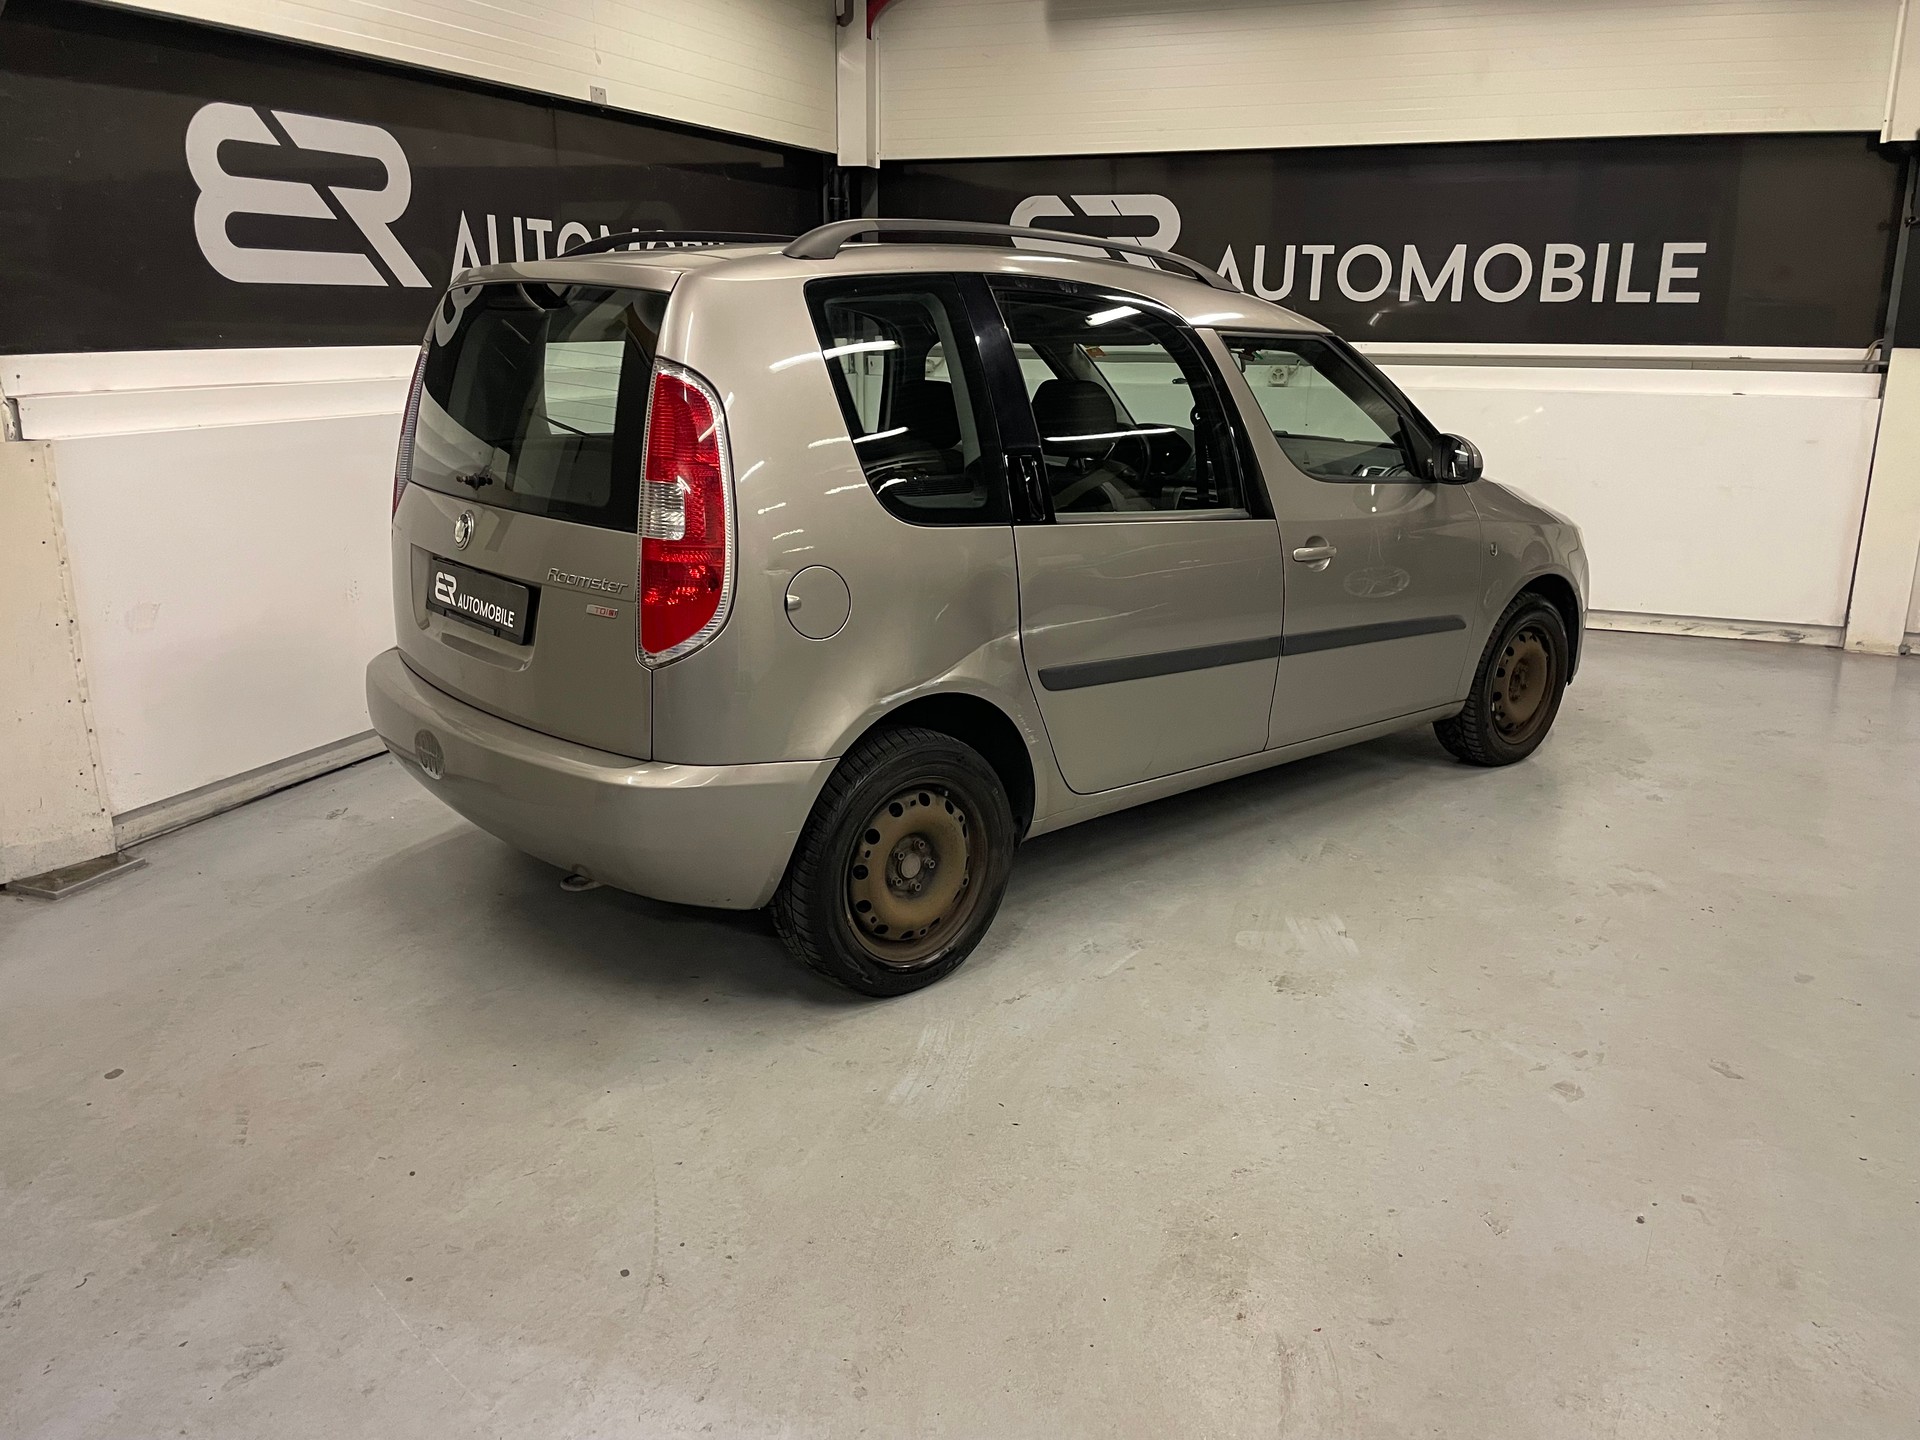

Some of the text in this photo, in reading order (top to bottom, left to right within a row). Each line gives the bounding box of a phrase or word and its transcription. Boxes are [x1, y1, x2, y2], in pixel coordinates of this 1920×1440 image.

[1216, 242, 1707, 304] AUTOMOBILE
[546, 567, 629, 594] Roomster
[457, 592, 515, 628] AUTOMOBILE
